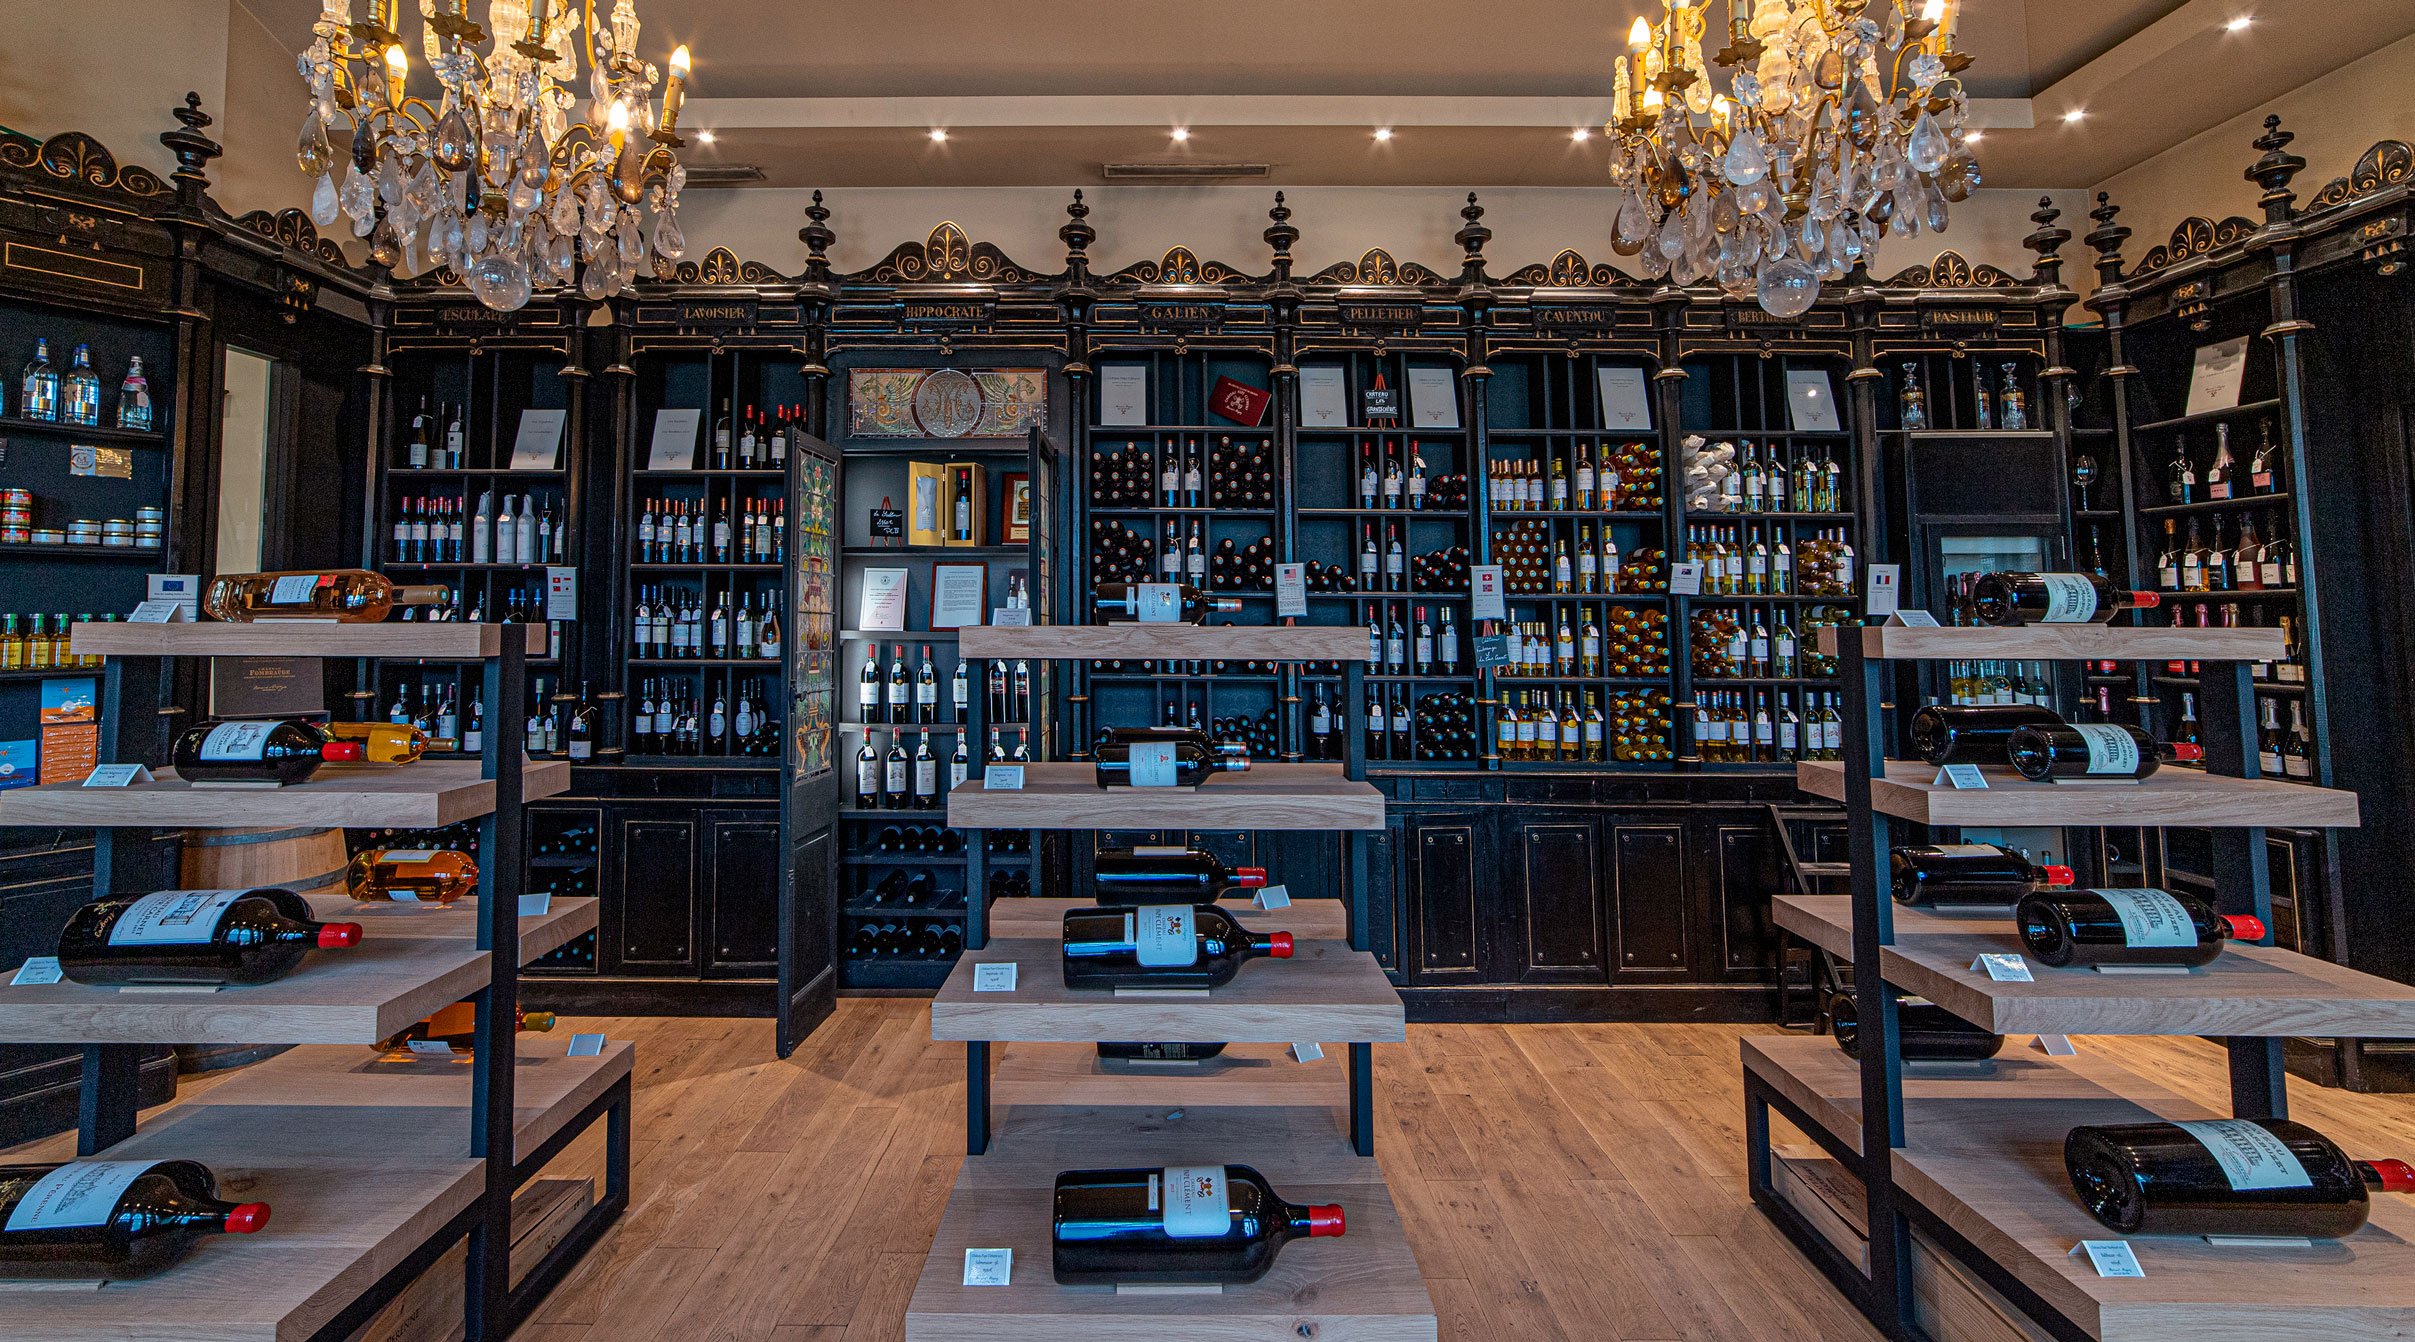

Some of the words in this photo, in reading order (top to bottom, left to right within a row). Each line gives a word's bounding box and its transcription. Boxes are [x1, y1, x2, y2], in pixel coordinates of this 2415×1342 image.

[684, 307, 745, 320] LAVOISIER
[906, 306, 984, 318] HIPPOCRATE
[1151, 307, 1209, 319] GALIEN
[1351, 308, 1414, 320] PELLETIER
[1545, 310, 1605, 322] CAVENTOU
[1933, 311, 1993, 323] PASTEUR
